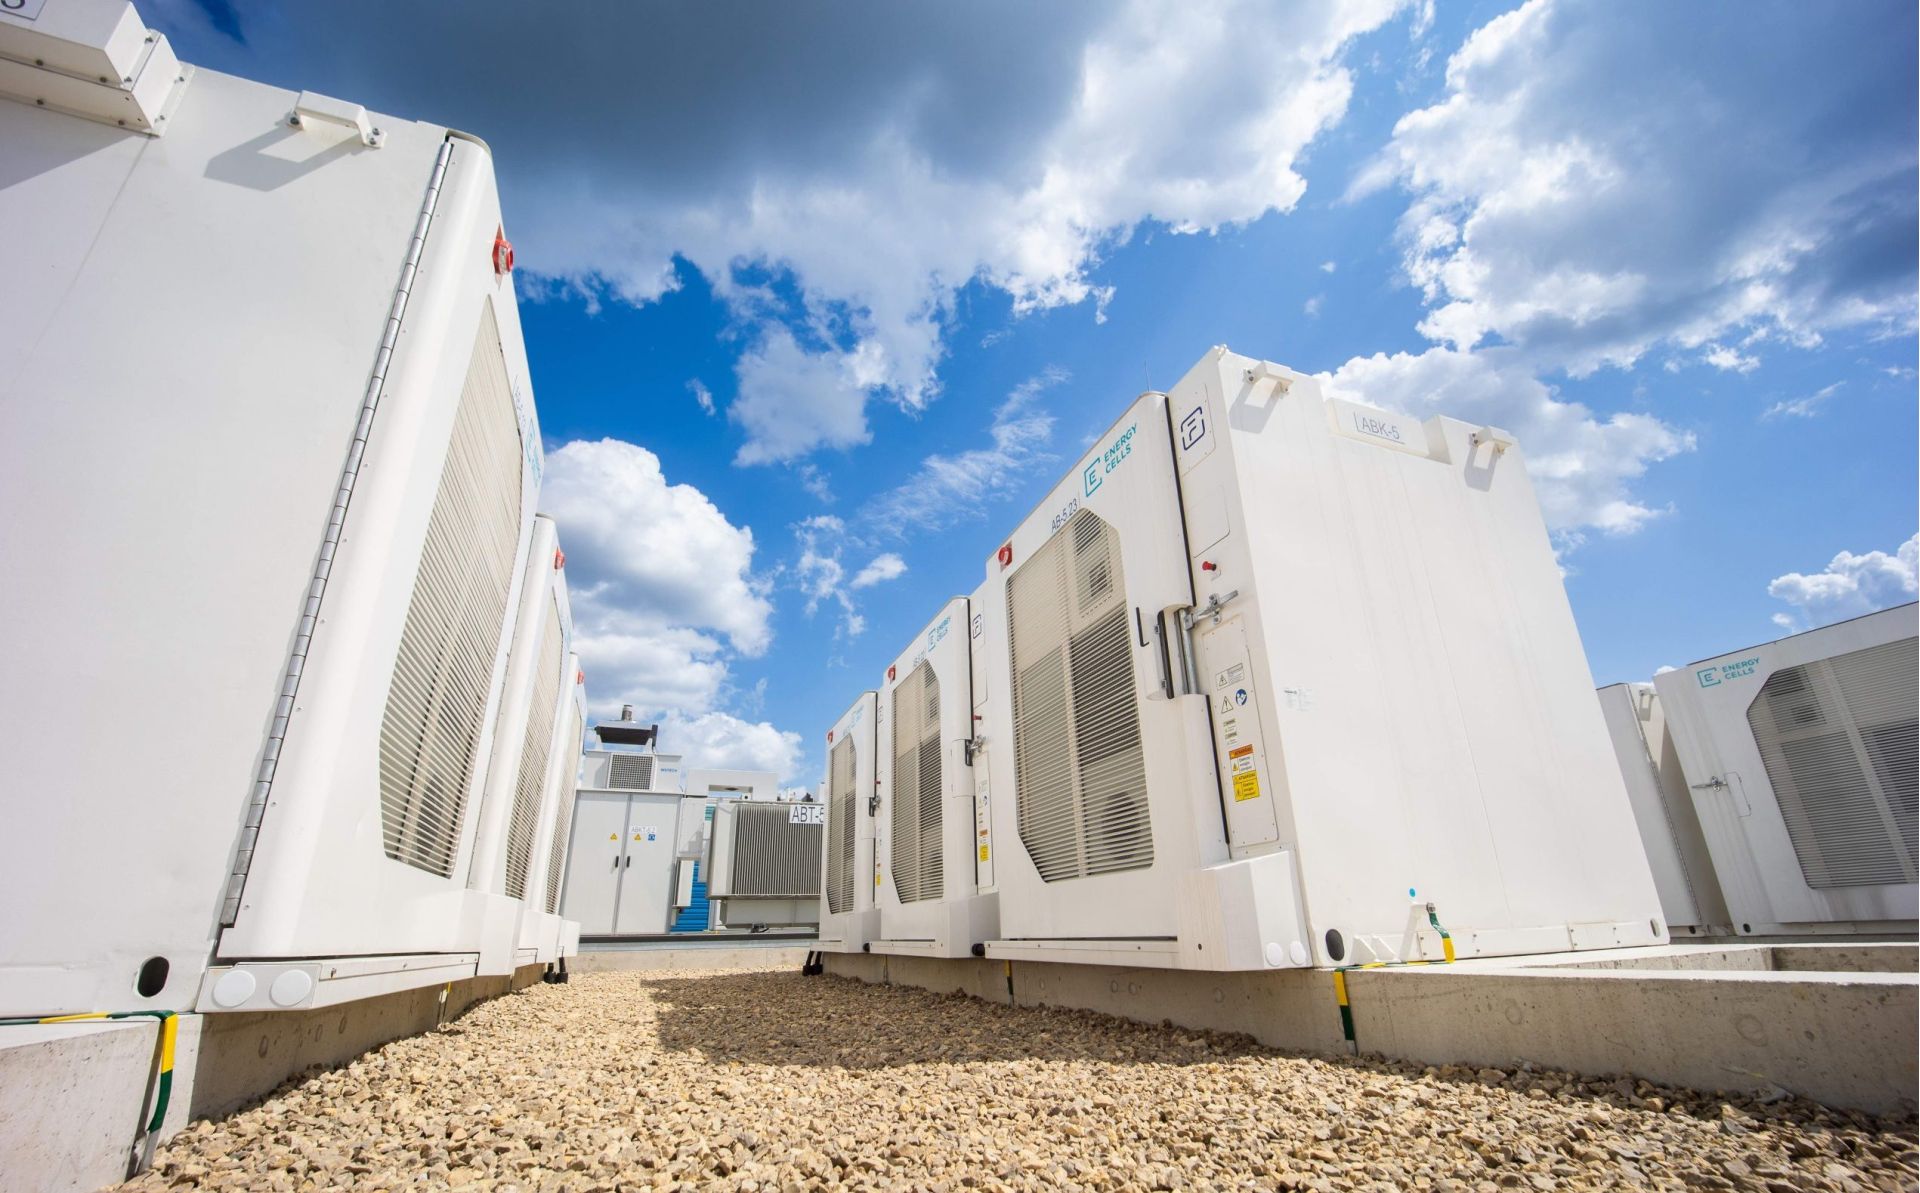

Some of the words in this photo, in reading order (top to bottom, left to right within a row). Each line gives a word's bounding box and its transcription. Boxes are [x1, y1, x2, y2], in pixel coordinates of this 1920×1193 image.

[1362, 416, 1400, 440] ABK-5
[1104, 423, 1137, 463] ENERGY
[1105, 443, 1132, 474] CELLS
[1722, 657, 1760, 673] ENERGY
[1725, 667, 1755, 680] CELLS
